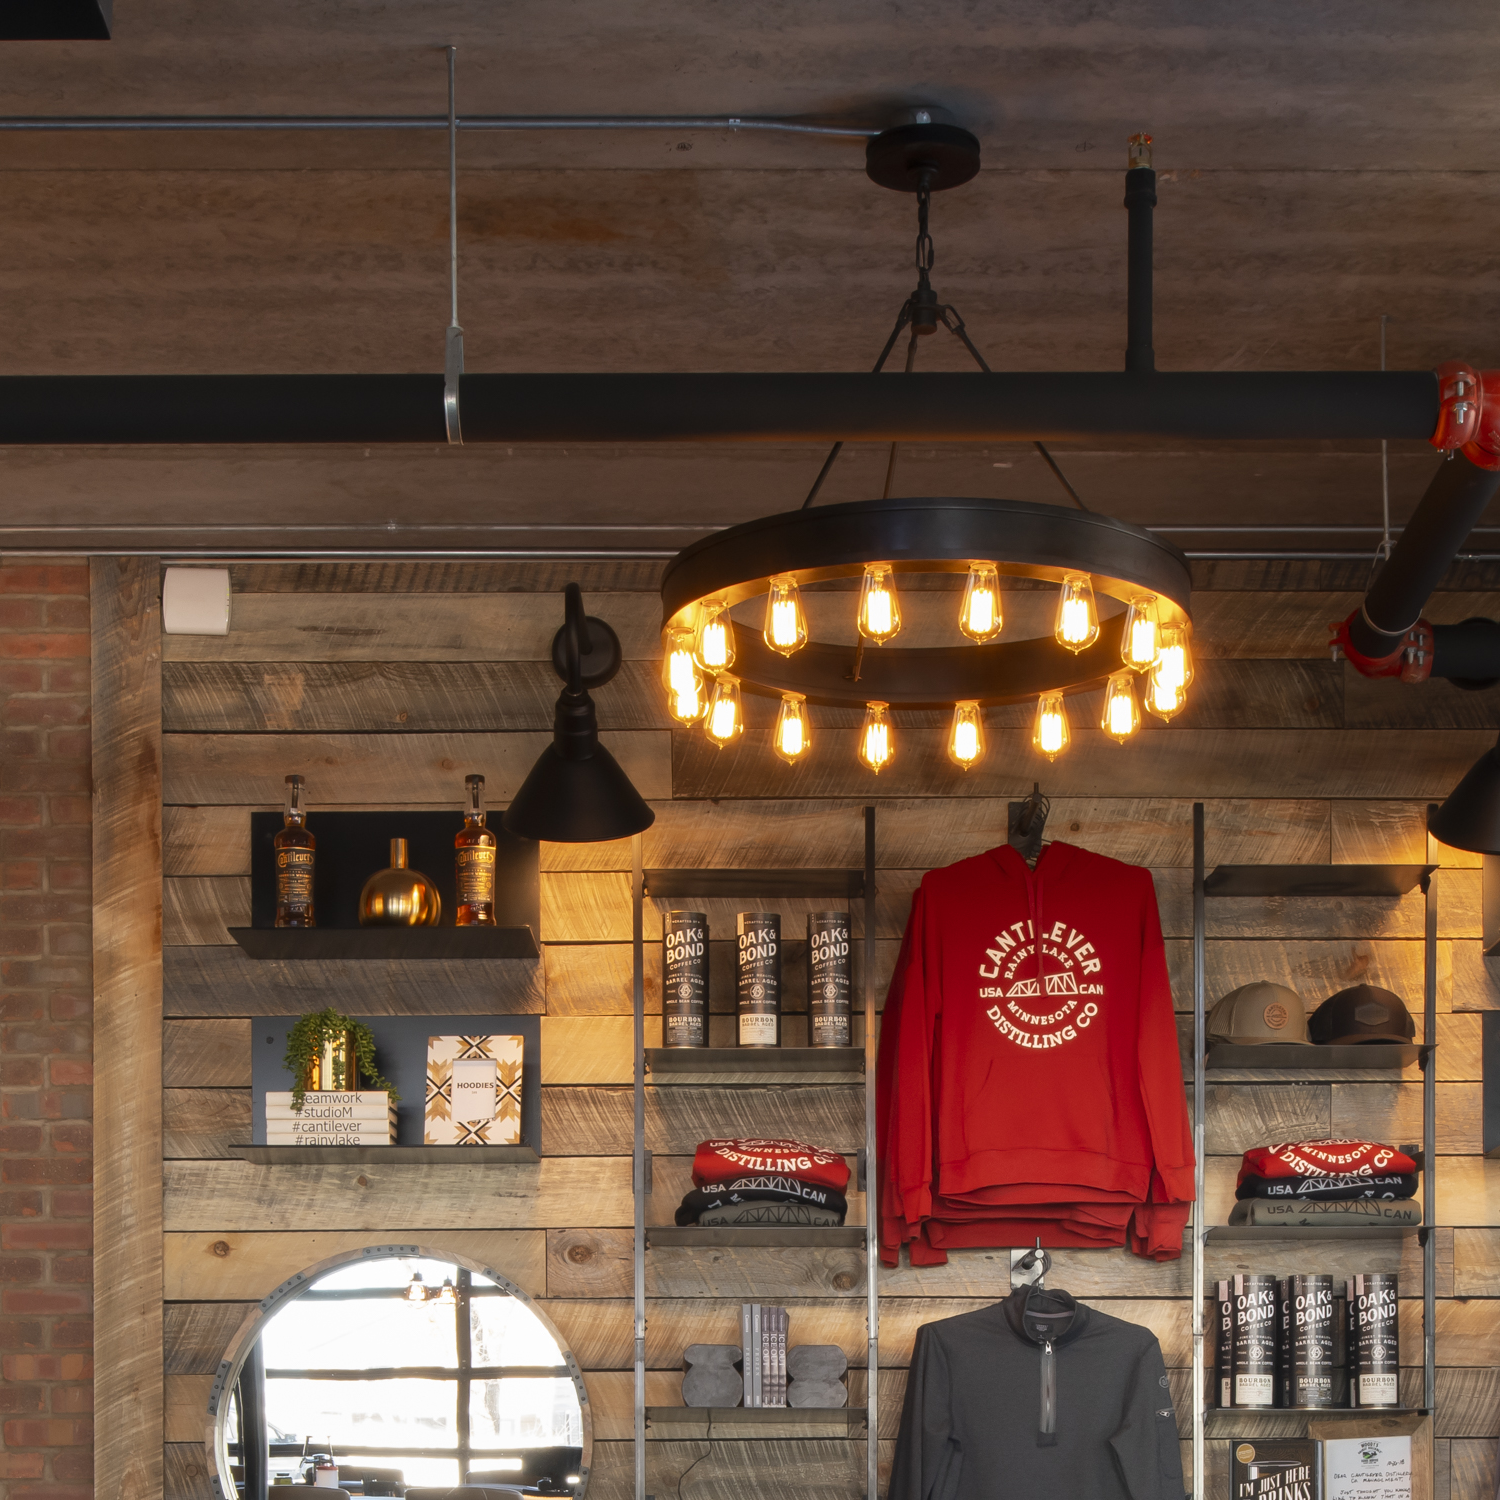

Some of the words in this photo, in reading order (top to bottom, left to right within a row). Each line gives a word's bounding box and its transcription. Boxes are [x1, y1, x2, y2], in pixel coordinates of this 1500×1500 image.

[667, 942, 704, 964] BOND
[739, 943, 777, 965] BOND
[812, 942, 848, 964] BOND
[1005, 944, 1035, 979] RAINY
[1042, 944, 1074, 969] LAKE
[669, 961, 692, 970] COFFEE
[742, 961, 764, 971] COFFEE
[815, 961, 837, 970] COFFEE
[739, 978, 760, 986] BARREL
[979, 987, 1004, 998] USA
[1079, 984, 1104, 995] CAN
[1007, 1000, 1078, 1025] MINNESOTA
[986, 1005, 1077, 1049] DISTILLING
[1076, 1002, 1098, 1028] CO
[294, 1106, 353, 1118] #studioM
[292, 1121, 362, 1133] #cantilever
[715, 1147, 812, 1172] DISTILLING
[1279, 1151, 1374, 1178] DISTILLING
[1373, 1149, 1394, 1168] CO
[1301, 1144, 1373, 1164] MINNESOTA
[702, 1184, 727, 1193] USA
[802, 1187, 827, 1204] CAN
[1267, 1185, 1293, 1195] USA
[1375, 1176, 1403, 1185] CAN
[1267, 1204, 1295, 1215] USA
[1383, 1208, 1412, 1220] CAN
[1237, 1304, 1274, 1325] BOND
[1295, 1304, 1332, 1325] BOND
[1358, 1303, 1396, 1325] BOND
[1241, 1322, 1264, 1332] COFFEE
[1299, 1322, 1322, 1332] COFFEE
[1362, 1322, 1385, 1332] COFFEE
[1239, 1482, 1254, 1498] I'M
[1258, 1473, 1282, 1494] JUST
[1285, 1465, 1311, 1484] HERE
